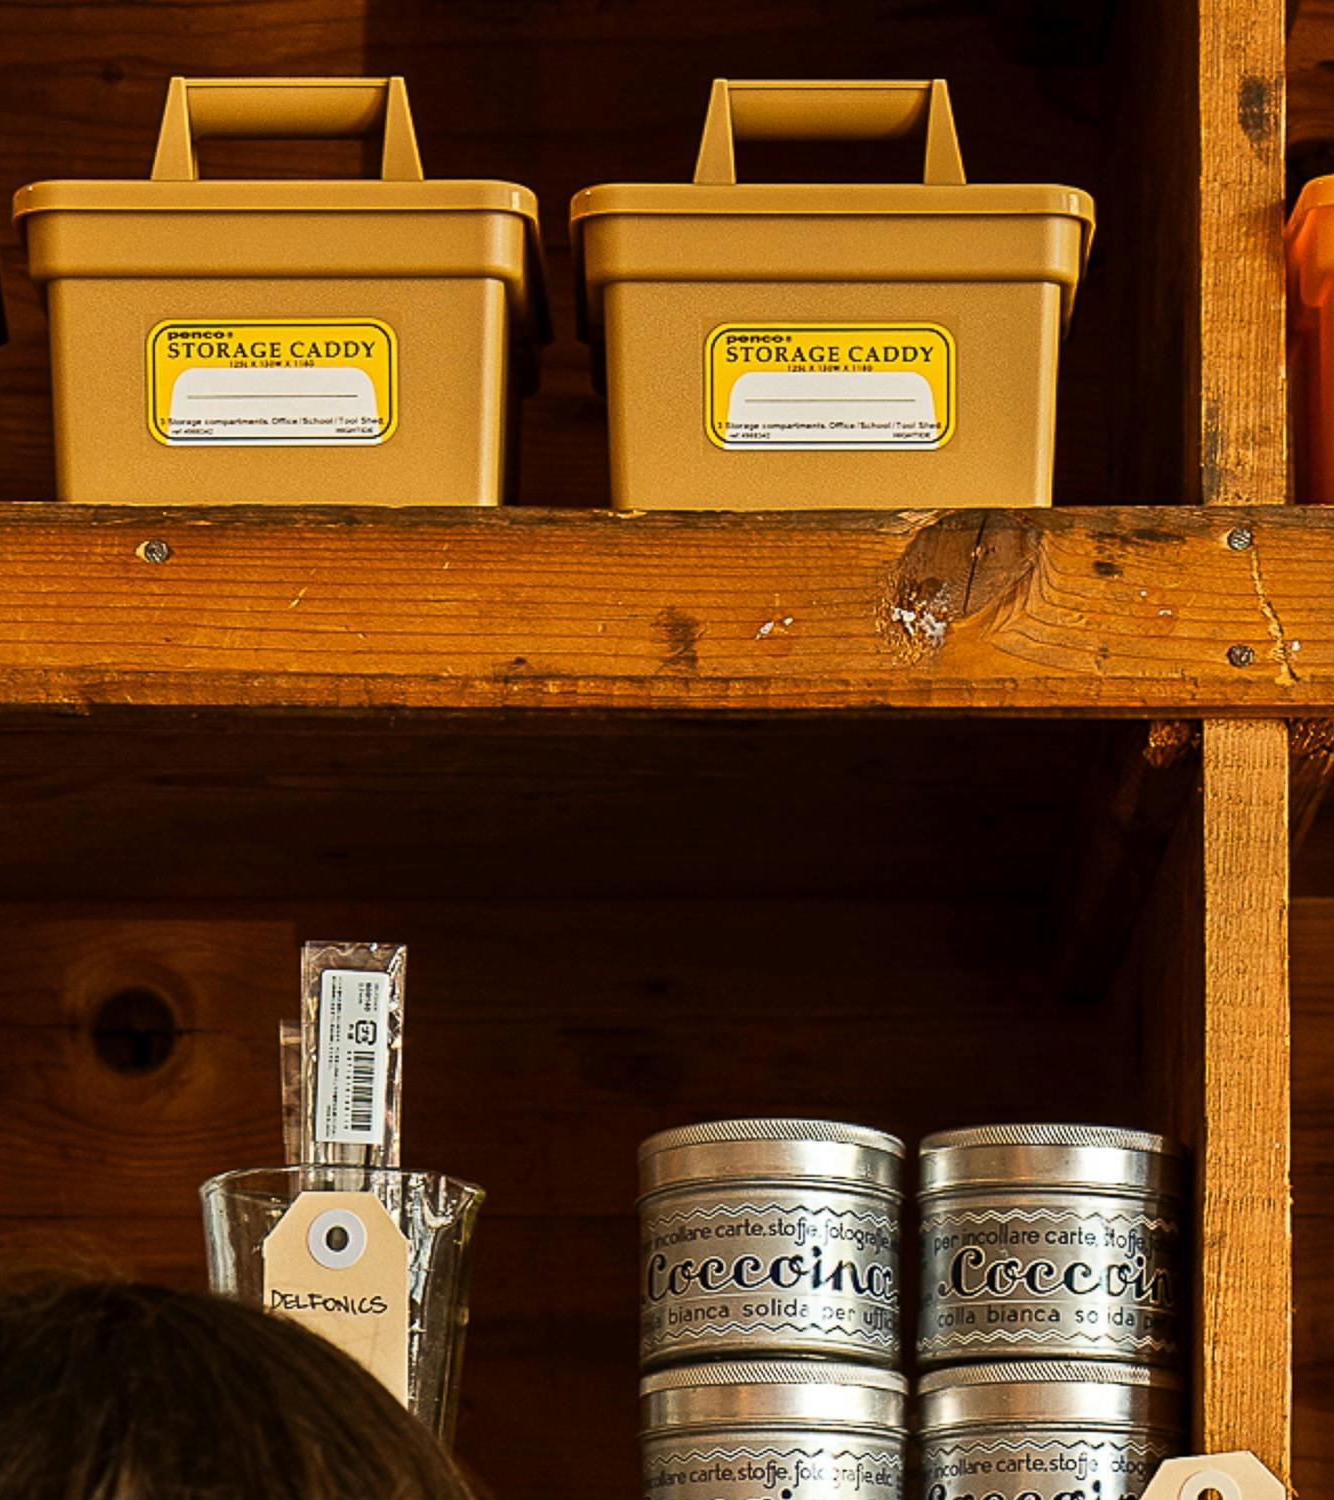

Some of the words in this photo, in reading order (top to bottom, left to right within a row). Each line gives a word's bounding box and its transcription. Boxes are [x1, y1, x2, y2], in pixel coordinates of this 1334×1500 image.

[168, 342, 281, 358] STORAGE
[290, 341, 376, 358] CADDY
[726, 346, 839, 362] STORAGE
[848, 346, 934, 362] CADDY
[962, 1225, 1040, 1246] incollare
[648, 1246, 897, 1301] Coccoina
[939, 1246, 1169, 1302] Coccoin
[271, 1289, 388, 1315] DELFONICS
[669, 1305, 730, 1326] bianca
[742, 1298, 809, 1318] solida
[822, 1306, 855, 1326] per
[938, 1307, 975, 1328] colla
[987, 1306, 1061, 1324] bianca
[1075, 1307, 1134, 1327] soida
